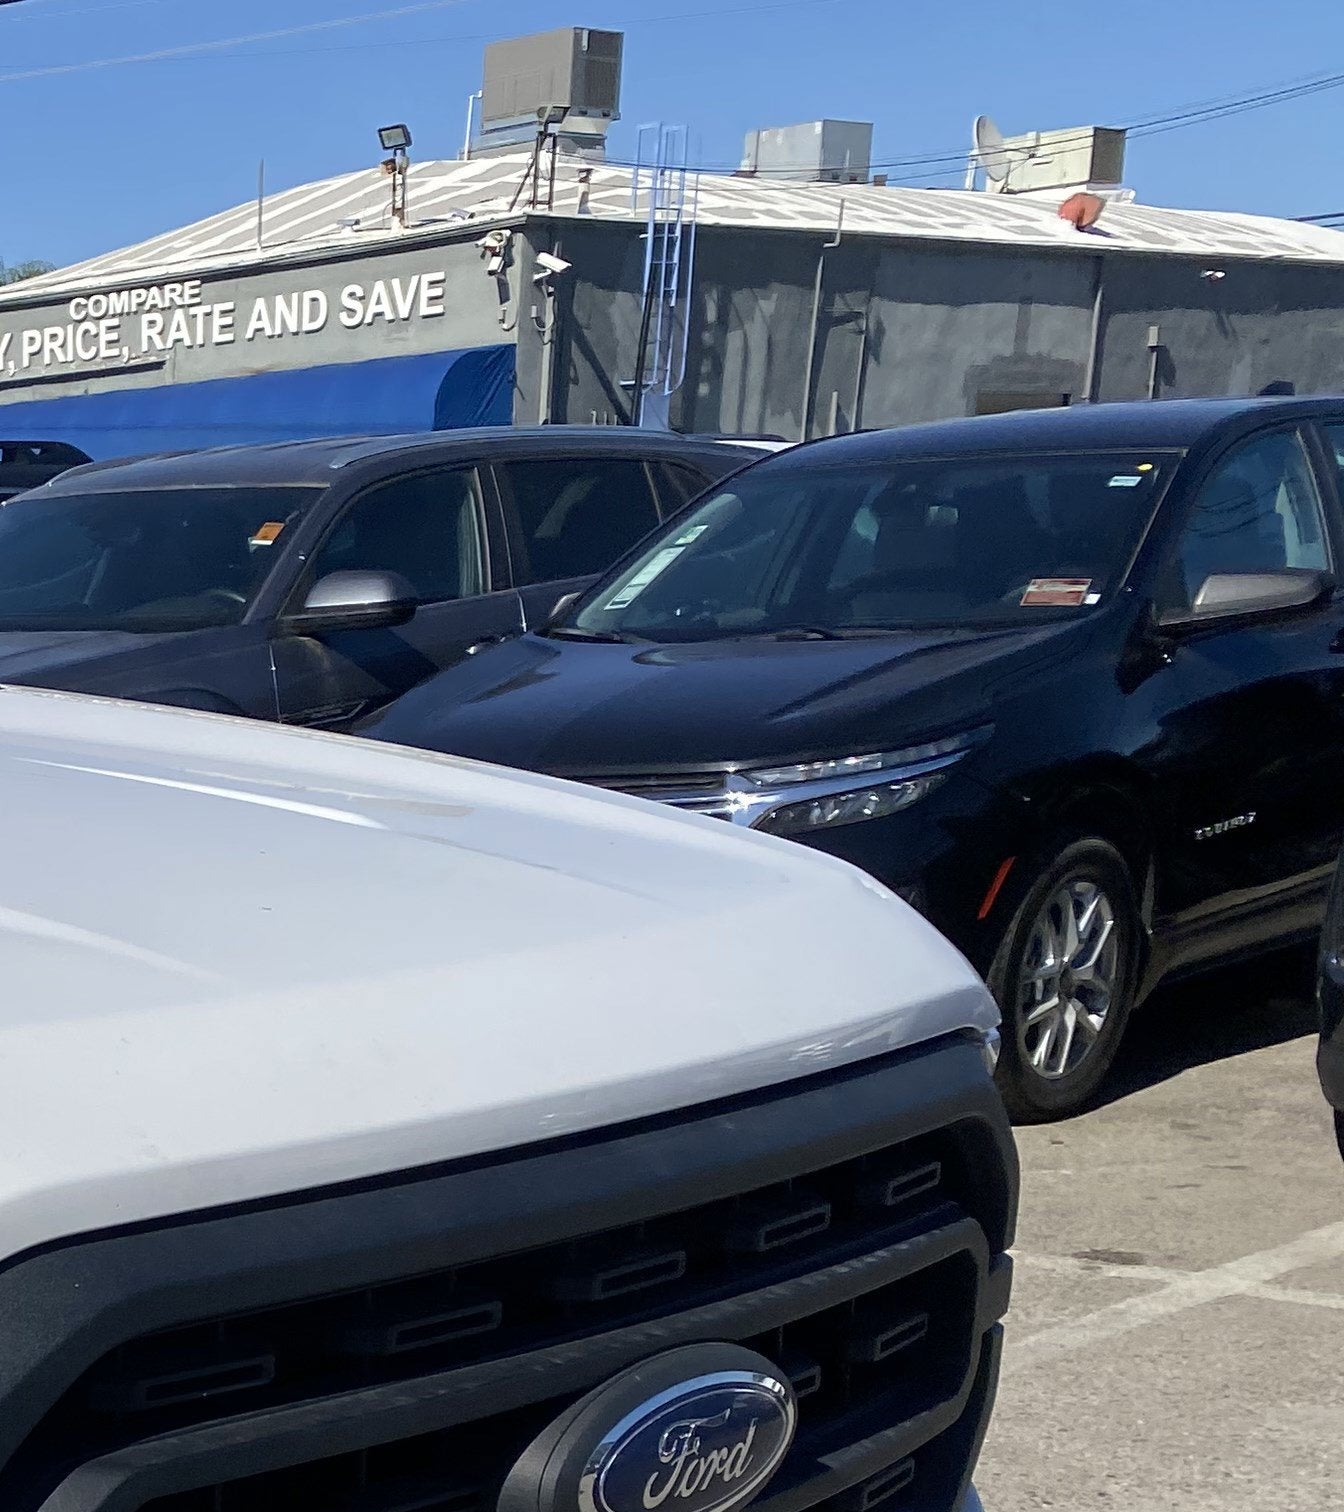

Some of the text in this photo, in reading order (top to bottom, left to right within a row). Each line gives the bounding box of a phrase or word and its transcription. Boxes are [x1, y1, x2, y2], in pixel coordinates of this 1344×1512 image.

[22, 318, 130, 365] PRICE,
[141, 301, 235, 352] RATE
[245, 289, 328, 341] AND
[339, 271, 446, 329] SAVE
[68, 280, 202, 321] COMPARE
[642, 1407, 759, 1510] Ford
